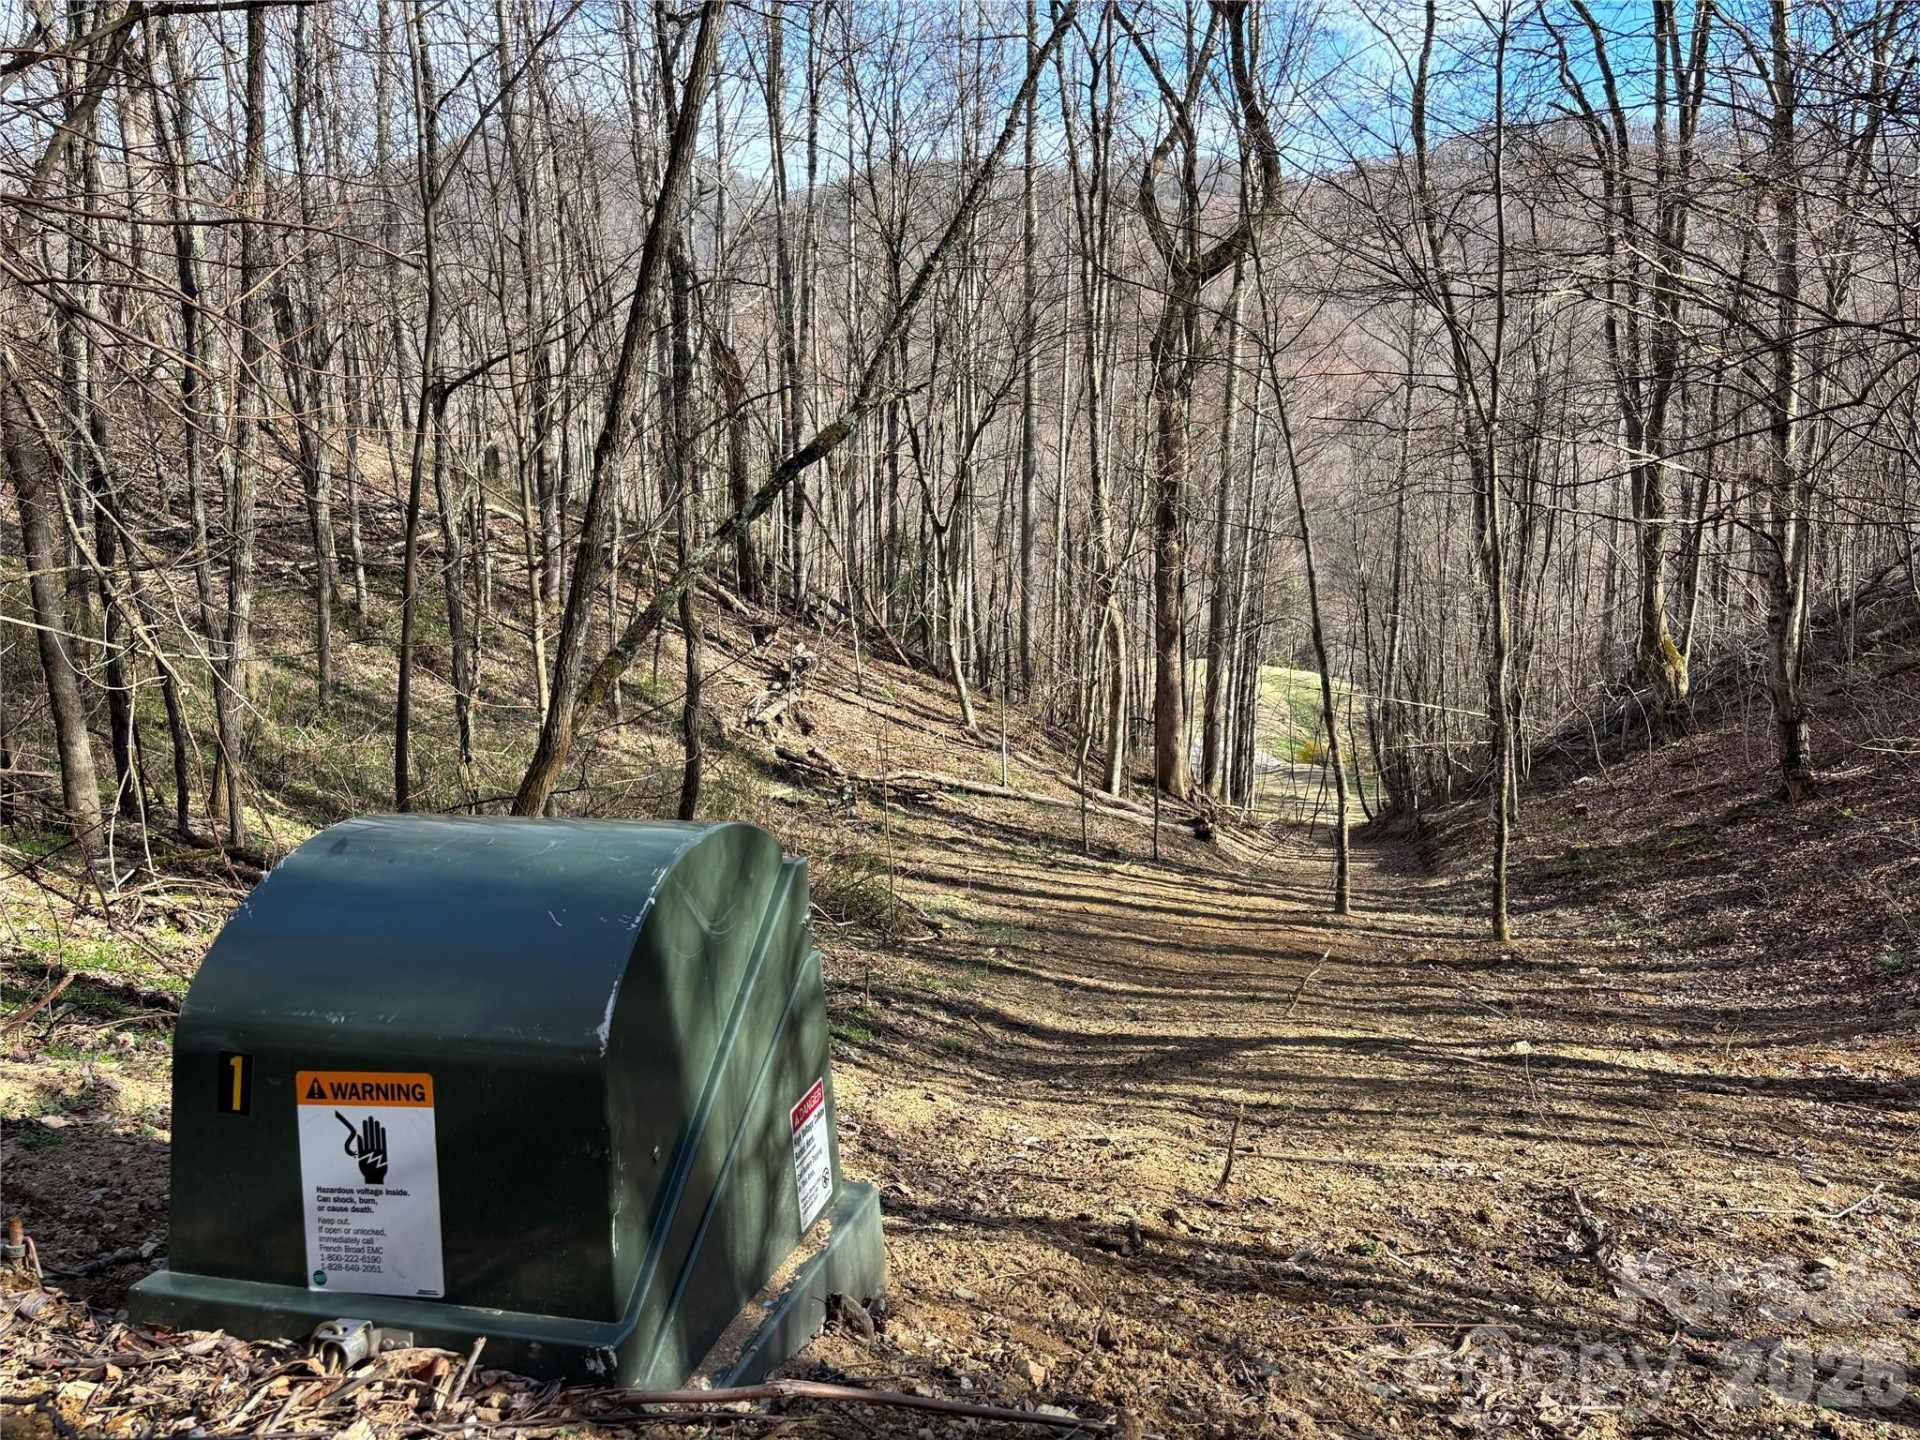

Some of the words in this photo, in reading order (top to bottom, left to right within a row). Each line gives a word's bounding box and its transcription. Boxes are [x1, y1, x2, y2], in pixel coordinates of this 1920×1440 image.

[229, 1055, 243, 1111] 1
[330, 1081, 426, 1102] WARNING
[798, 1087, 822, 1121] DANGER
[316, 1186, 354, 1195] Hazardous
[356, 1188, 384, 1197] voltage
[316, 1195, 331, 1203] Can
[333, 1196, 357, 1205] shock,
[359, 1197, 378, 1206] burn,
[327, 1205, 349, 1213] cause
[350, 1205, 374, 1214] death.
[317, 1216, 335, 1225] Keep
[353, 1228, 387, 1237] unlocked,
[318, 1236, 360, 1245] immediately
[361, 1237, 374, 1245] call
[319, 1244, 342, 1252] French
[344, 1245, 365, 1254] Broad
[366, 1246, 384, 1254] EMC
